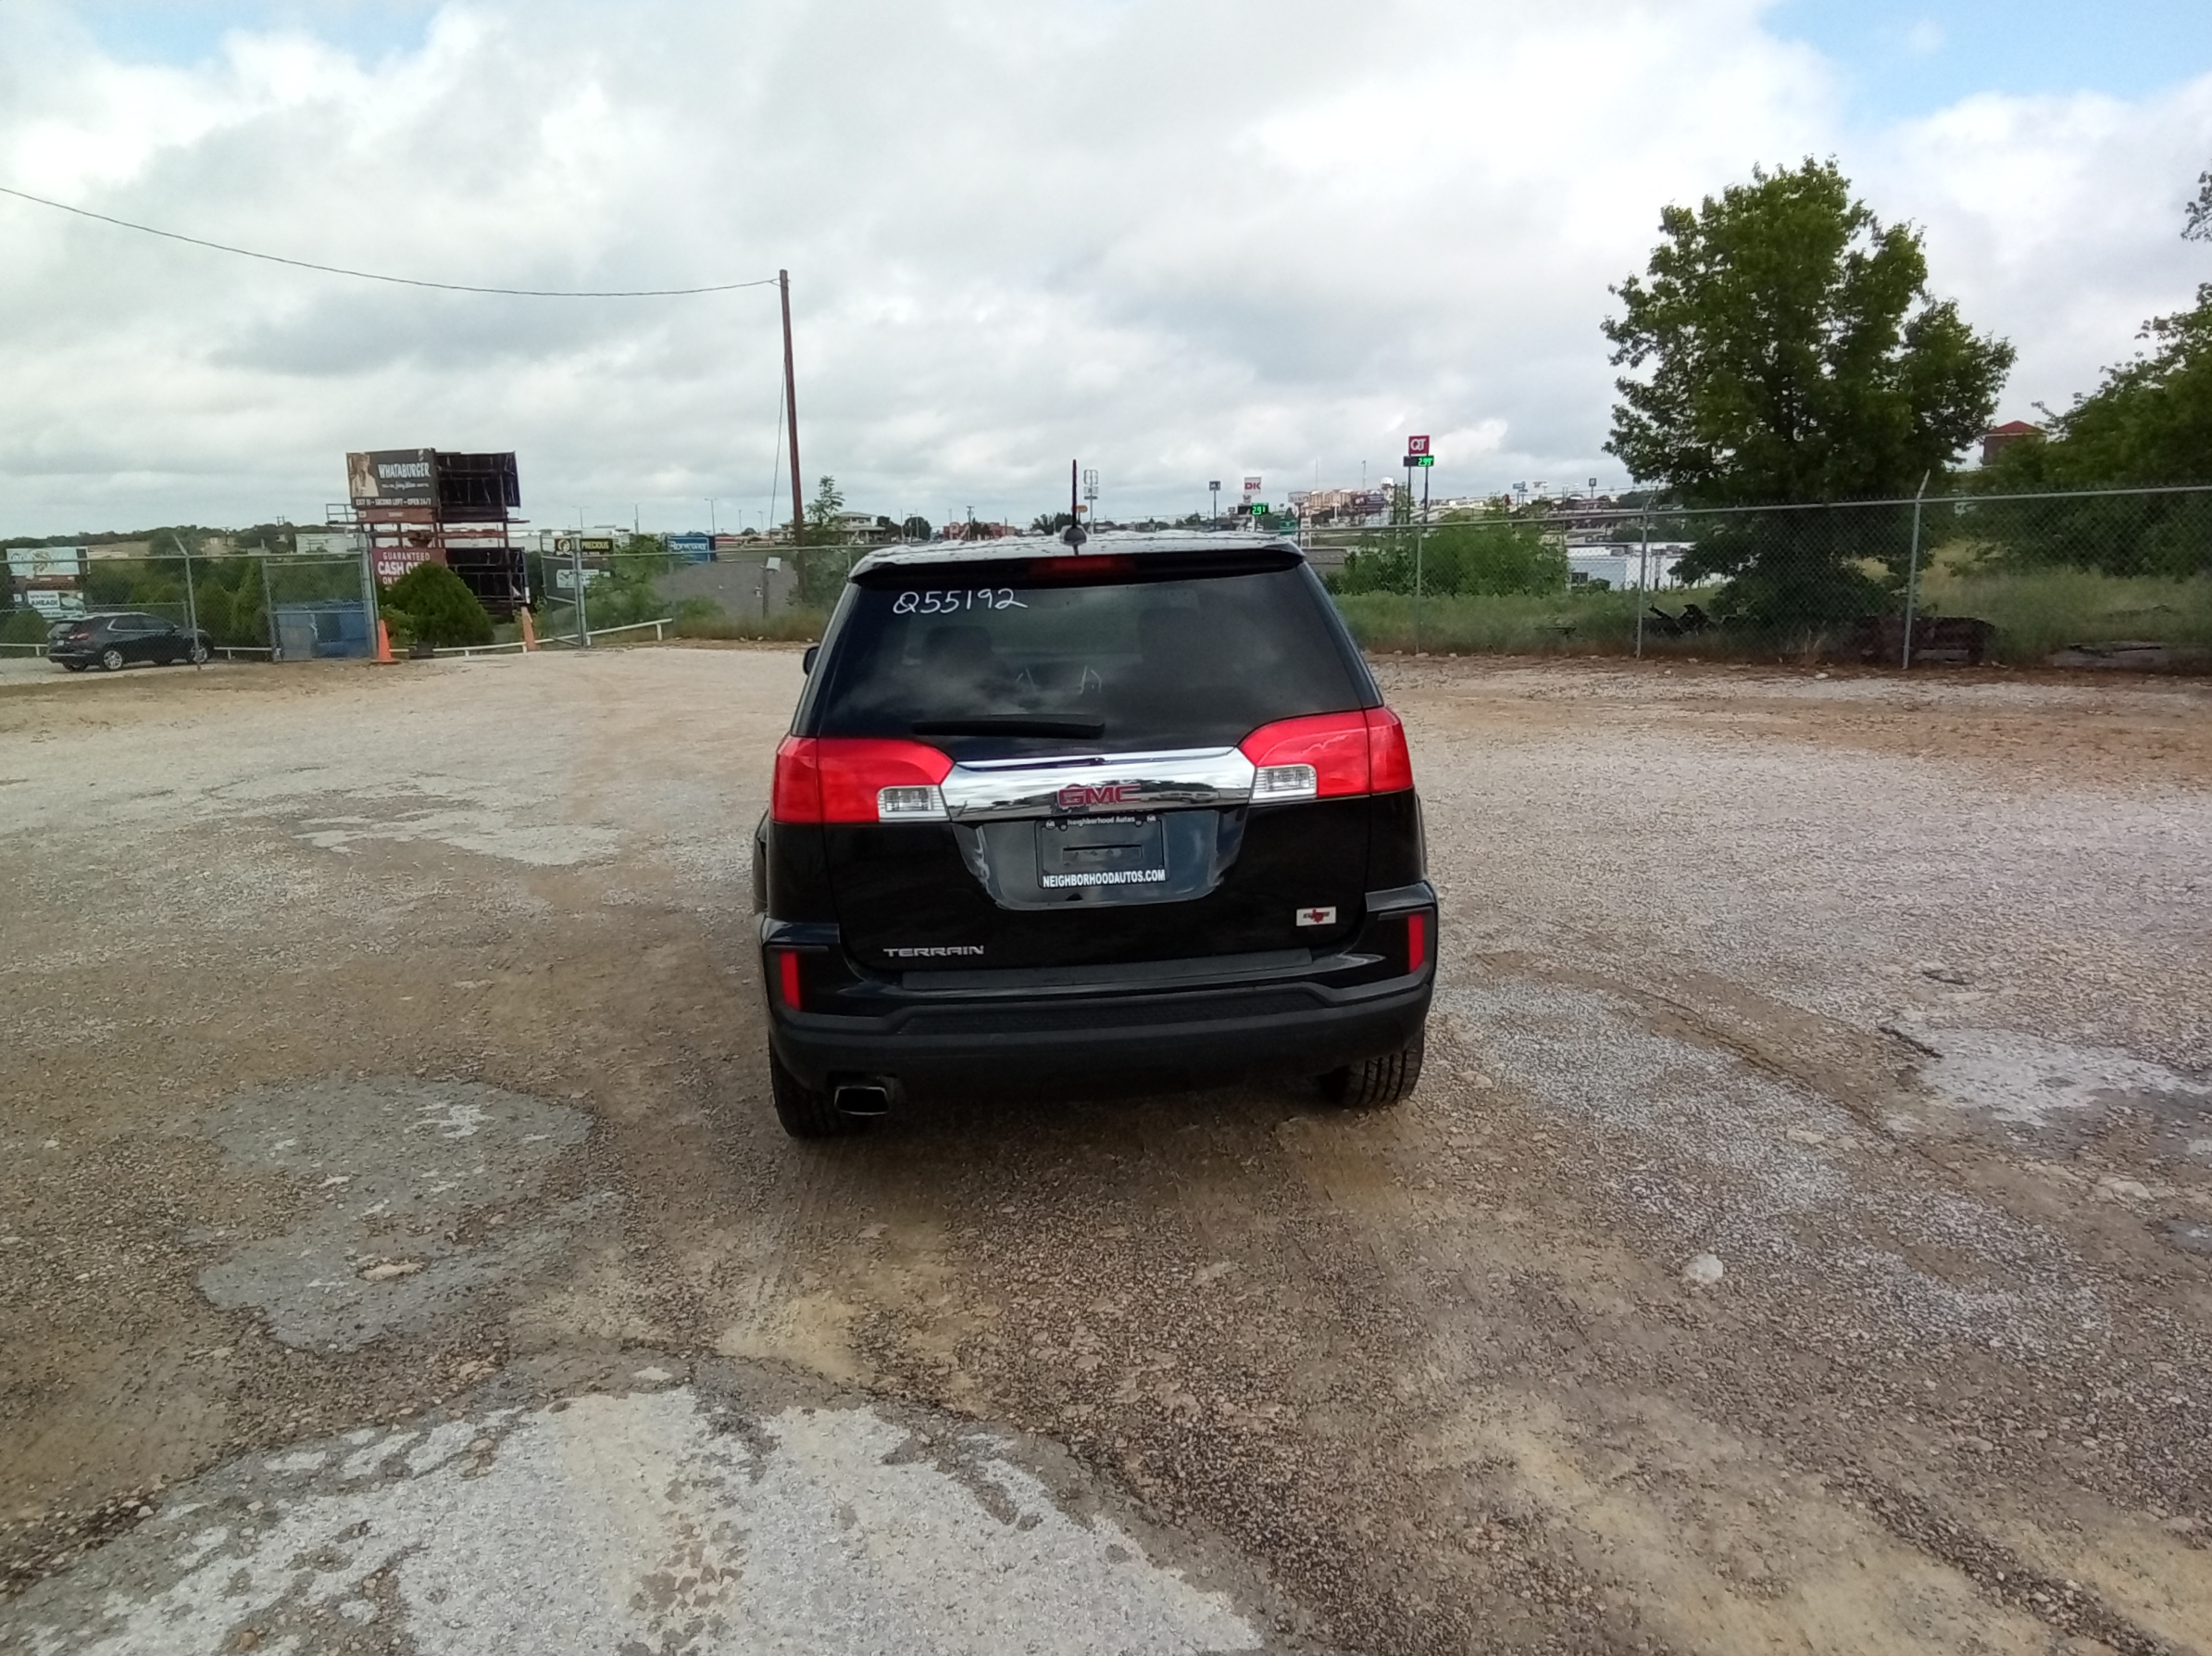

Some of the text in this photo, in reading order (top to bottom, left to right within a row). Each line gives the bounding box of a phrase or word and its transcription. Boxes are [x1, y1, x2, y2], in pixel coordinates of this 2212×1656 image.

[1410, 438, 1427, 451] QT
[378, 462, 431, 479] WHATABURGER
[1244, 482, 1261, 490] DK
[382, 551, 431, 561] GUARANTEED
[378, 561, 405, 575] CASH
[382, 576, 393, 585] ON
[893, 588, 1029, 614] Q55192
[1057, 784, 1142, 807] GMC
[1067, 816, 1136, 827] Neighborhood Autos
[1043, 869, 1166, 888] NEIGHBORHOODAUTOS.COM
[882, 945, 984, 958] TERRAIN
